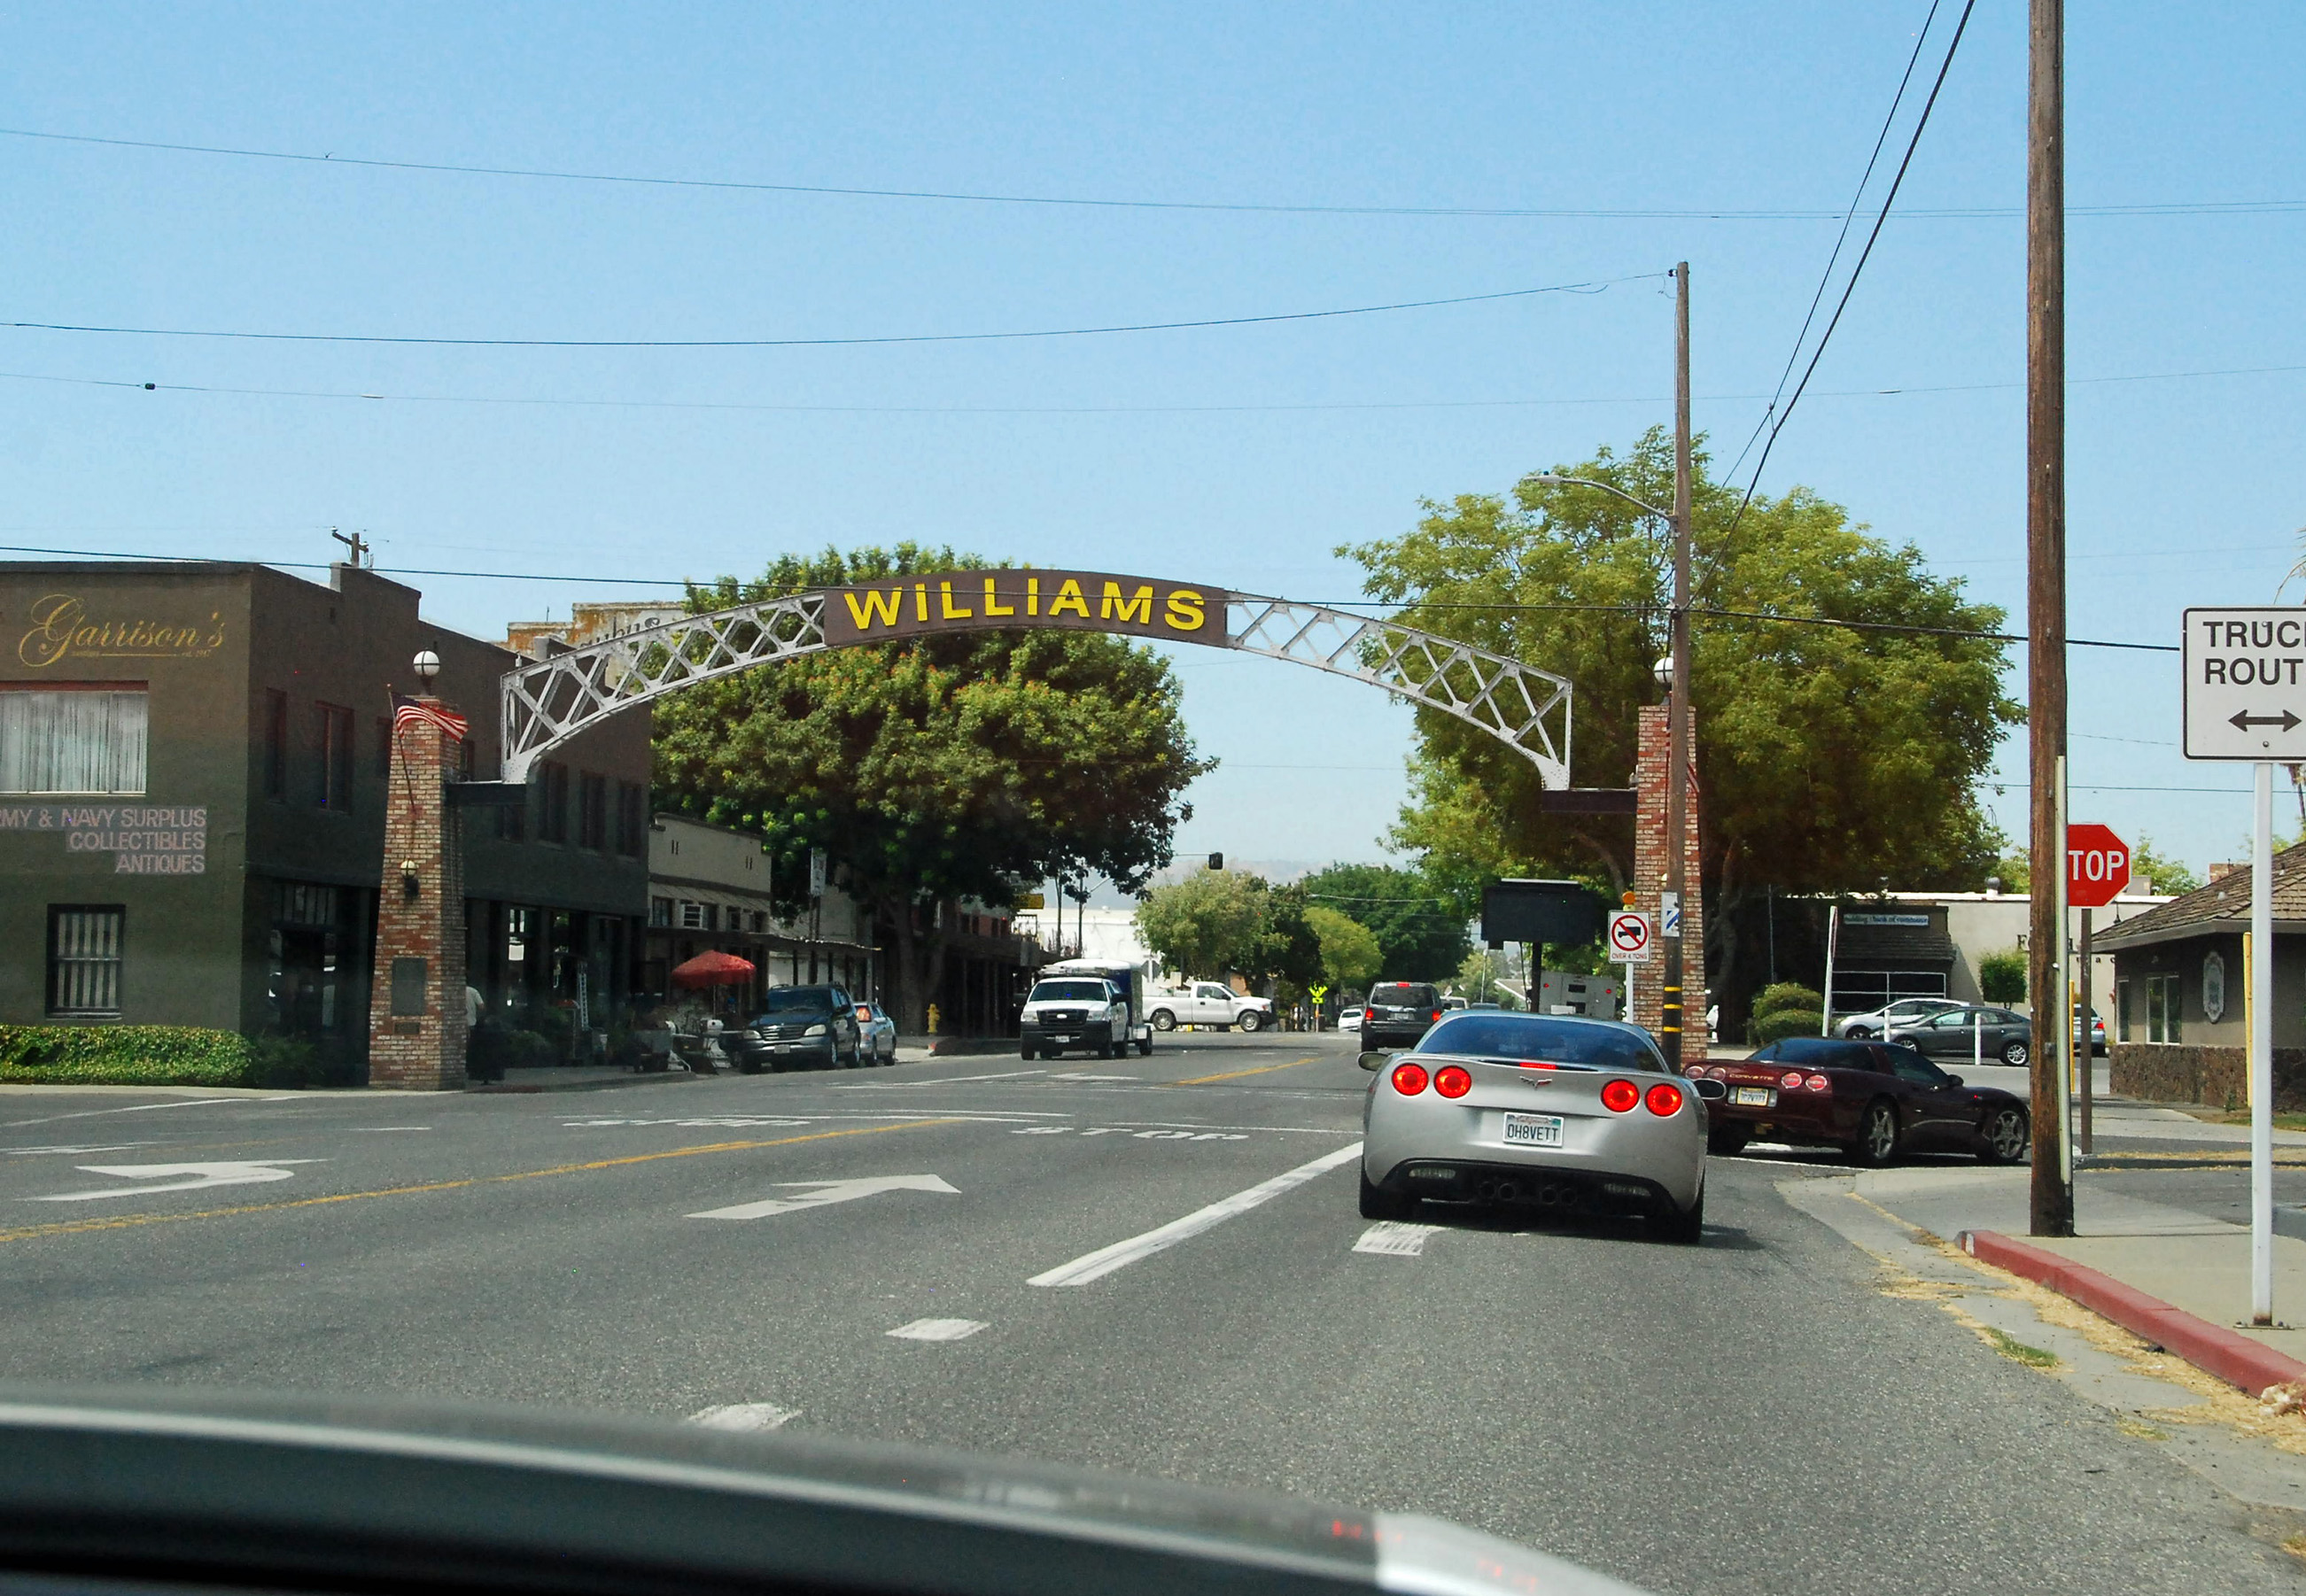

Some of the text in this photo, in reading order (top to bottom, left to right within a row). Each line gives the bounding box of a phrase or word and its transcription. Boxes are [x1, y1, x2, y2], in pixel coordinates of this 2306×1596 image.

[844, 577, 1205, 631] WILLIAMS
[19, 593, 225, 667] Garrison's
[2202, 621, 2306, 648] TRUC
[38, 809, 53, 828] &
[61, 808, 116, 828] NAVY
[120, 809, 207, 828] SURPLUS
[69, 831, 206, 851] COLLECTIBLES
[115, 854, 206, 874] ANTIQUES
[2068, 849, 2125, 881] TOP
[1008, 1126, 1250, 1141] STOP
